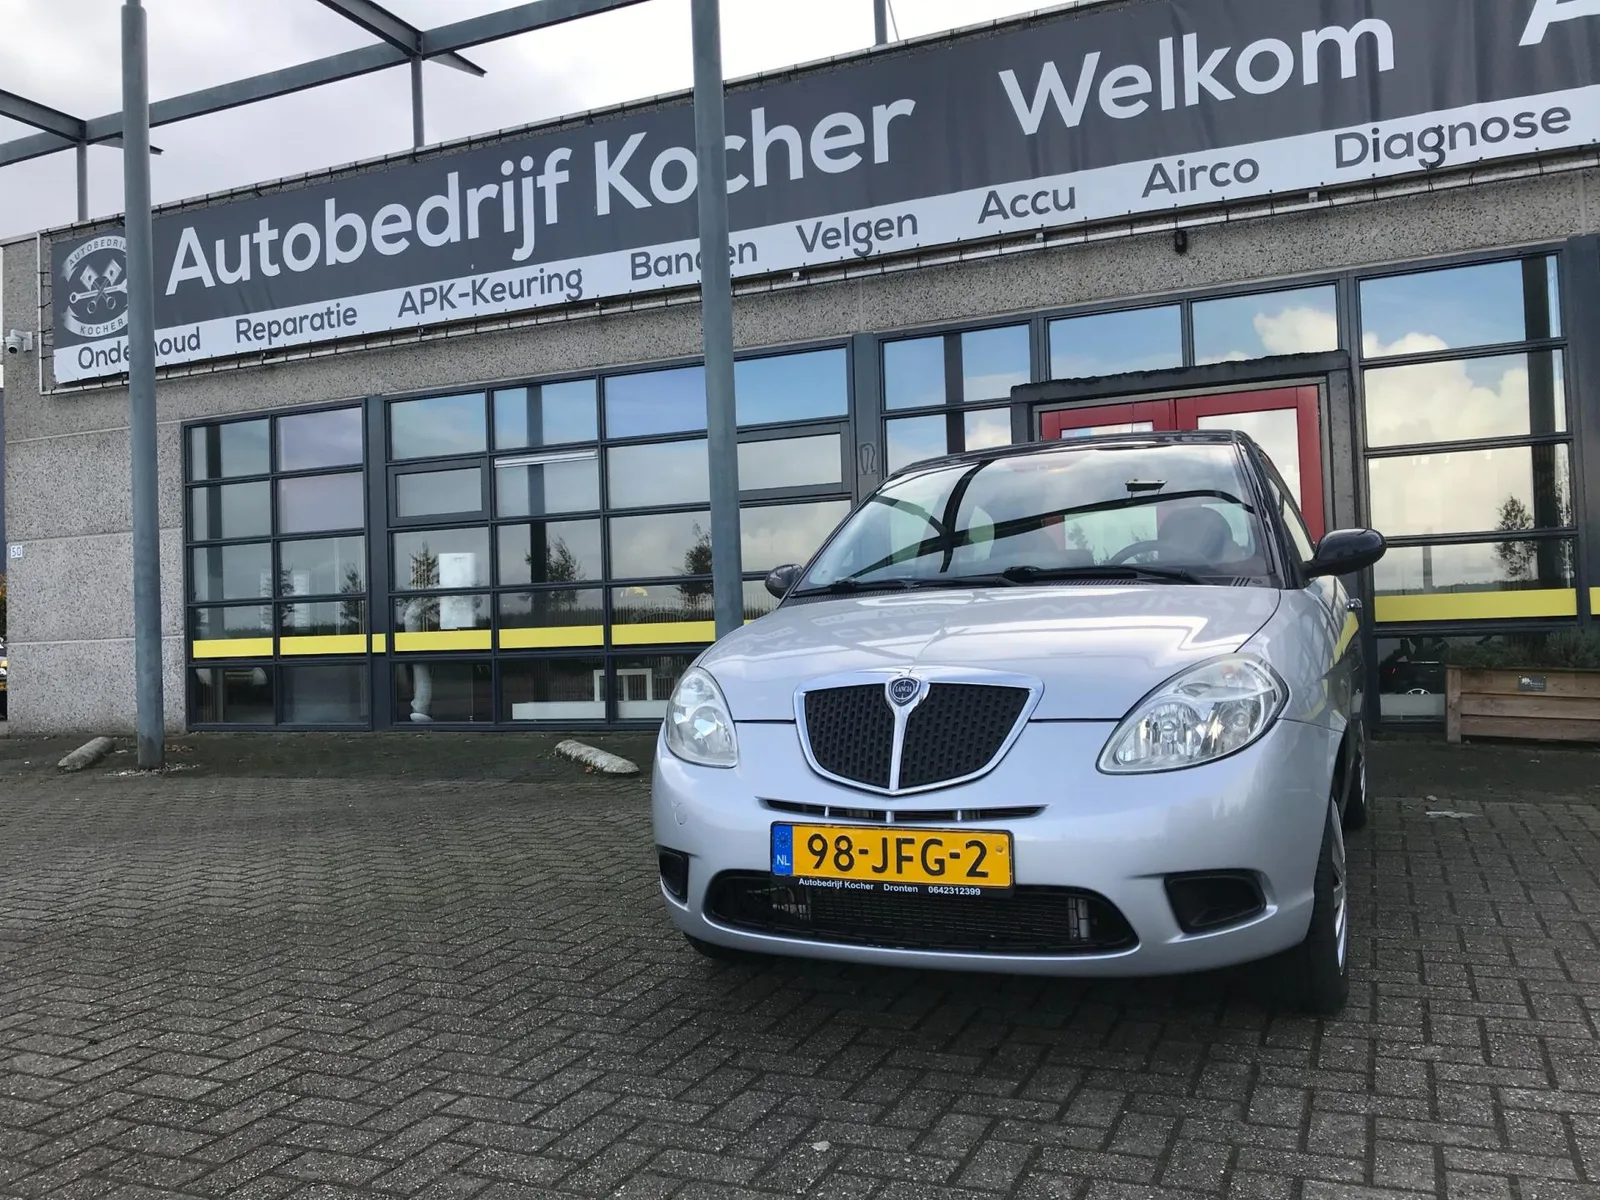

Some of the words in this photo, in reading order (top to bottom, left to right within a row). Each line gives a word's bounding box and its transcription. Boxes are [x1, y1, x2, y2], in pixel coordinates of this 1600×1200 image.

[165, 147, 572, 296] Autobedrijf
[594, 99, 916, 216] Kocher
[998, 18, 1394, 135] Welkom
[235, 302, 357, 345] Reparatie
[397, 268, 583, 318] APK-Keuring
[796, 213, 918, 256] Velgen
[977, 186, 1076, 224] Accu
[1141, 158, 1260, 198] Airco
[1334, 106, 1571, 168] Diagnose
[80, 318, 124, 335] KOCHER
[776, 855, 790, 866] NL
[807, 833, 989, 878] 98-JFG-2
[799, 877, 843, 890] Autobedrijf
[844, 881, 875, 891] Kocher
[883, 883, 918, 893] Dronten
[928, 886, 981, 896] 0642312399
